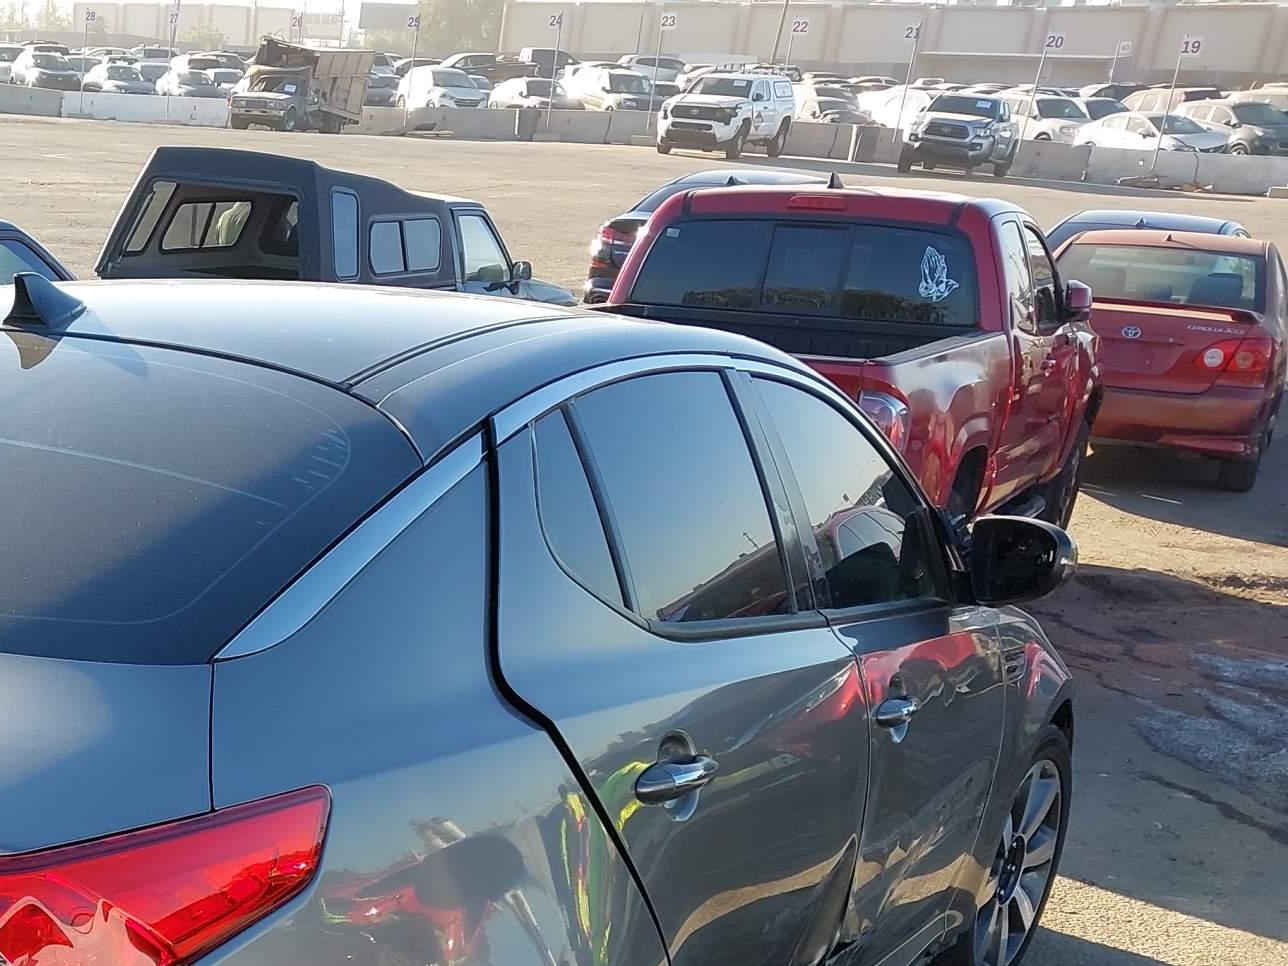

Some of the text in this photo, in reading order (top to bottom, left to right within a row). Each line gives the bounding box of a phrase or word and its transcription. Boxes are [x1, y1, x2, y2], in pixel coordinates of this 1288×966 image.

[85, 11, 96, 22] 28
[408, 17, 420, 28] 25
[662, 15, 676, 27] 23
[792, 21, 809, 33] 22
[904, 26, 920, 39] 21
[1046, 35, 1064, 49] 20
[1181, 40, 1201, 54] 19
